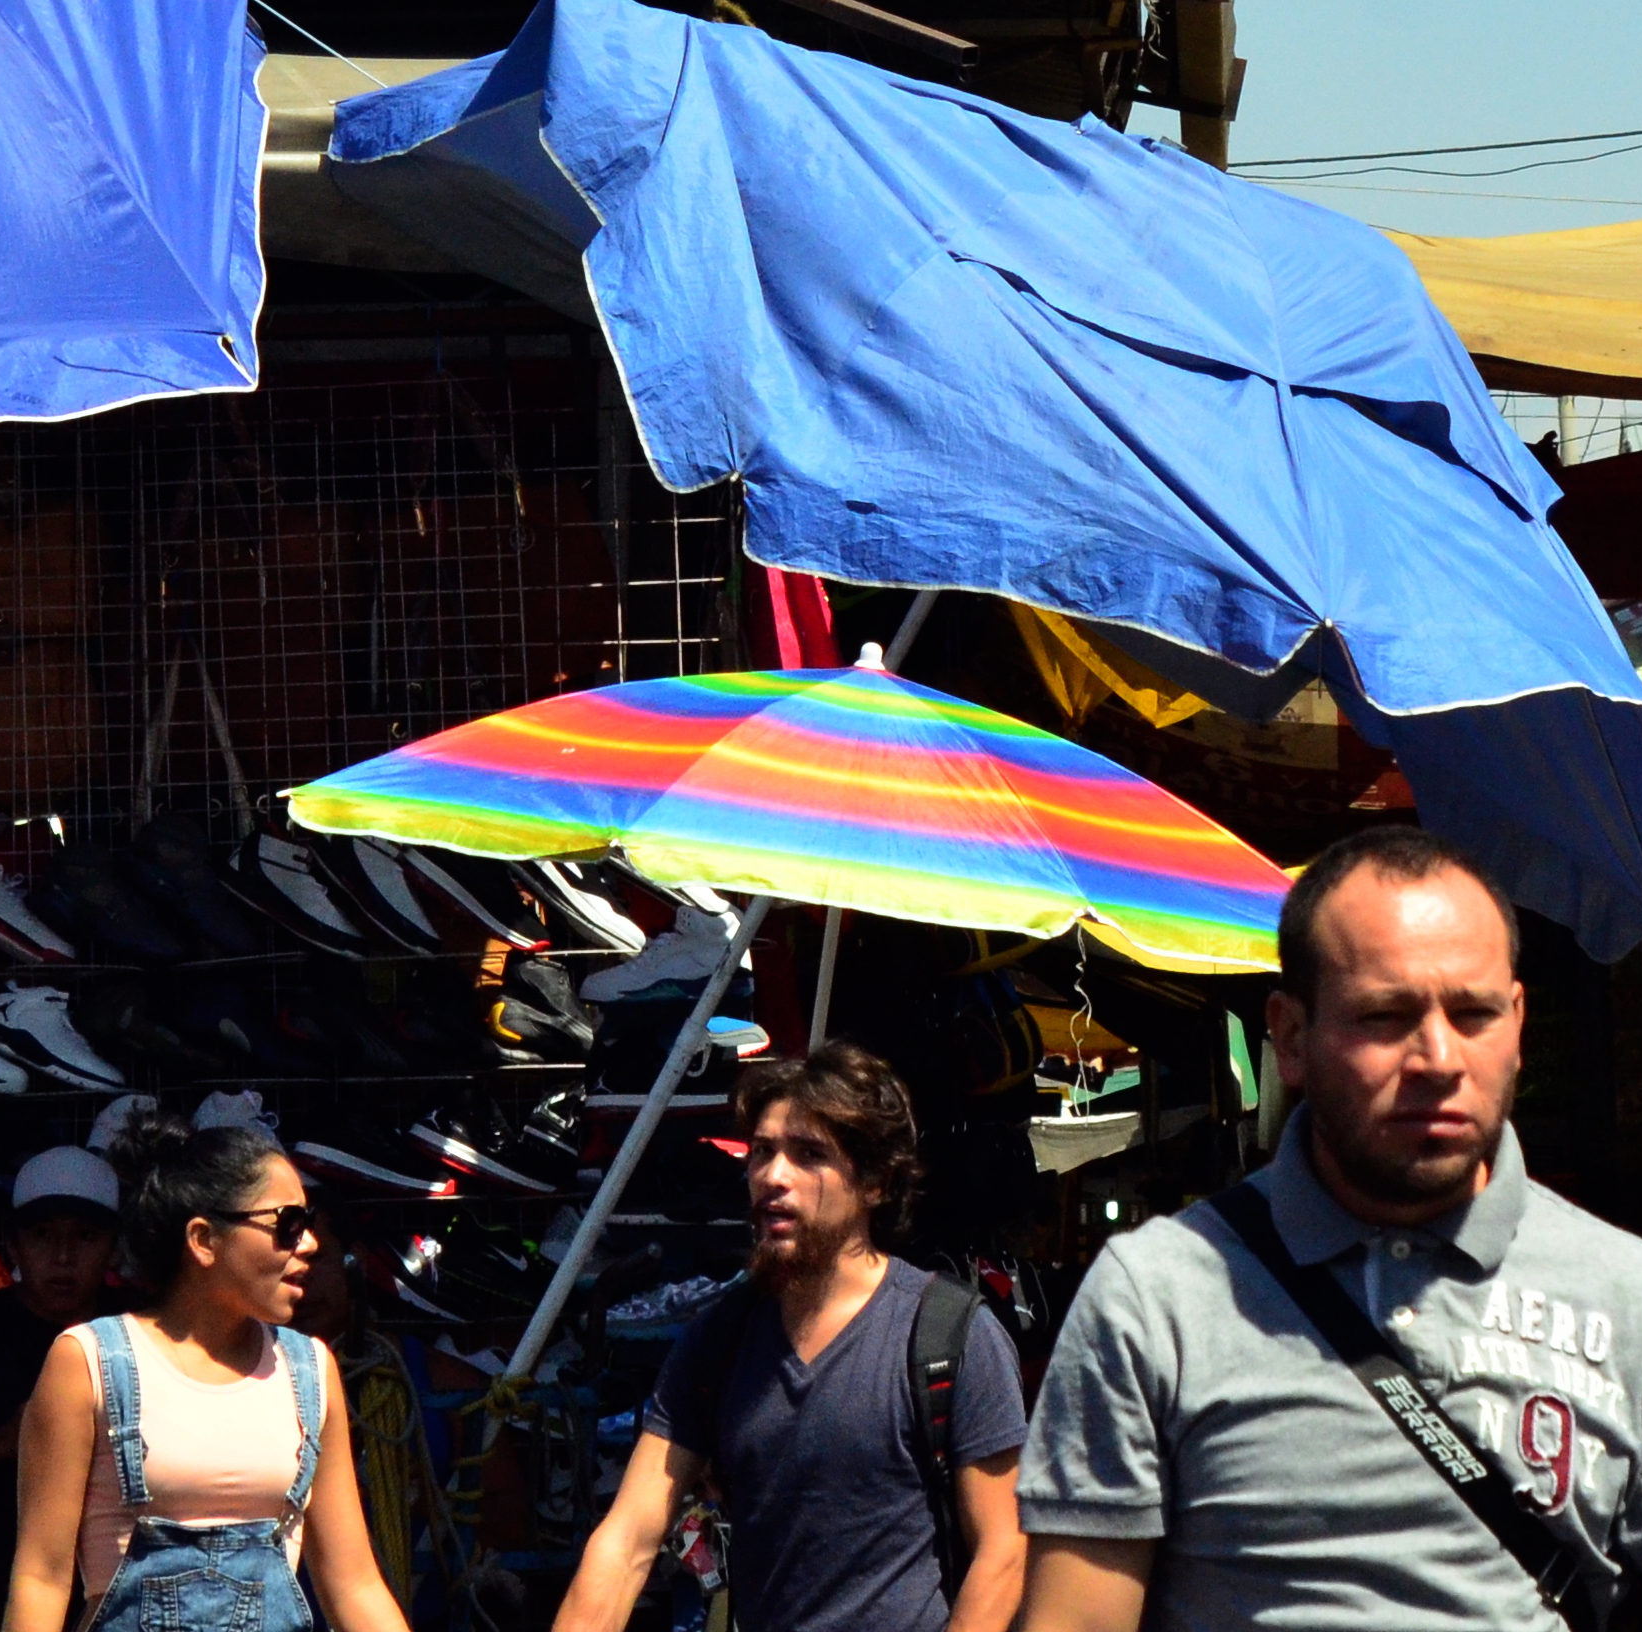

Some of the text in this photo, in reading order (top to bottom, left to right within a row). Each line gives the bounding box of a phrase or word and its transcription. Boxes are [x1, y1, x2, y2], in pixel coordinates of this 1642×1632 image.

[1481, 1280, 1612, 1364] AERO
[1373, 1377, 1474, 1484] FERRARI
[1395, 1375, 1488, 1479] SCUDERIA
[1476, 1392, 1606, 1516] N 9 Y
